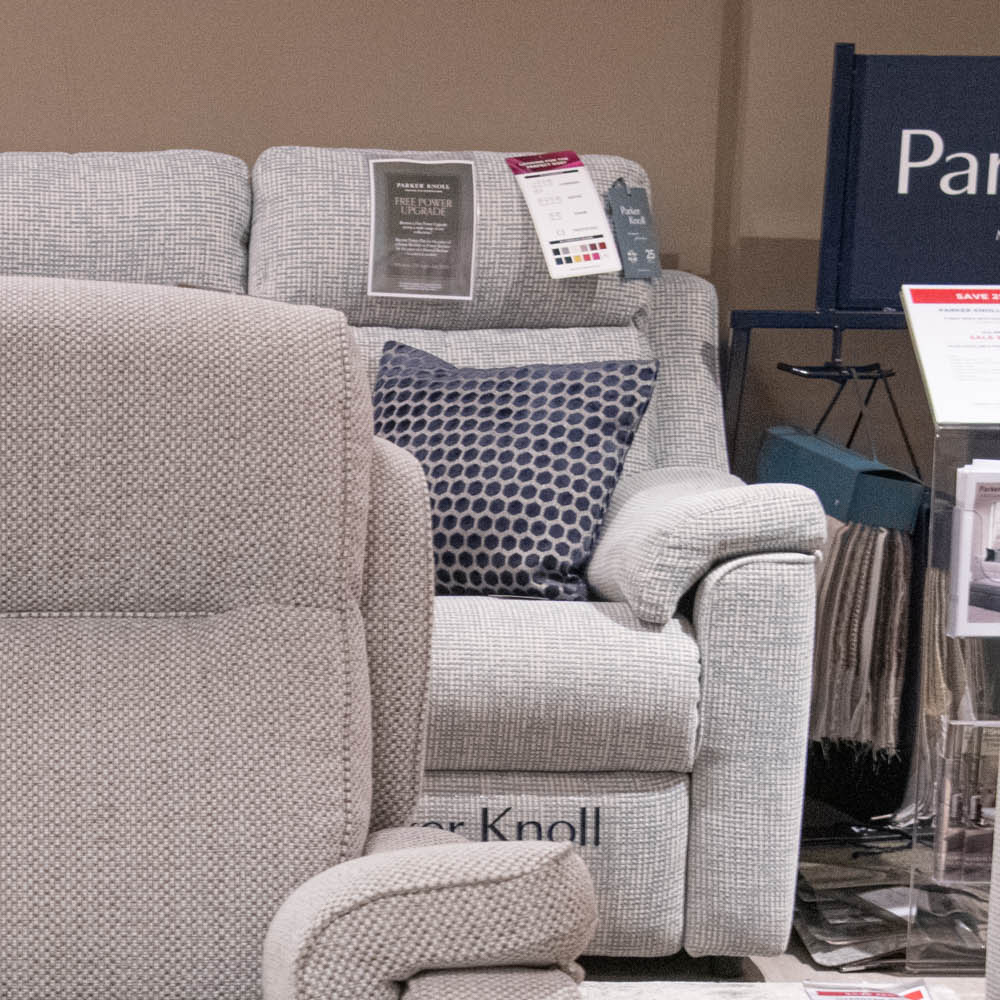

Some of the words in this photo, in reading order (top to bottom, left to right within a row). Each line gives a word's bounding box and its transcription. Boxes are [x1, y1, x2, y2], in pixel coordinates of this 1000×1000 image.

[898, 129, 1000, 195] Par
[394, 197, 417, 206] FREE
[418, 199, 453, 208] POWER
[400, 206, 447, 216] UPGRADE
[481, 806, 600, 846] Knoll
